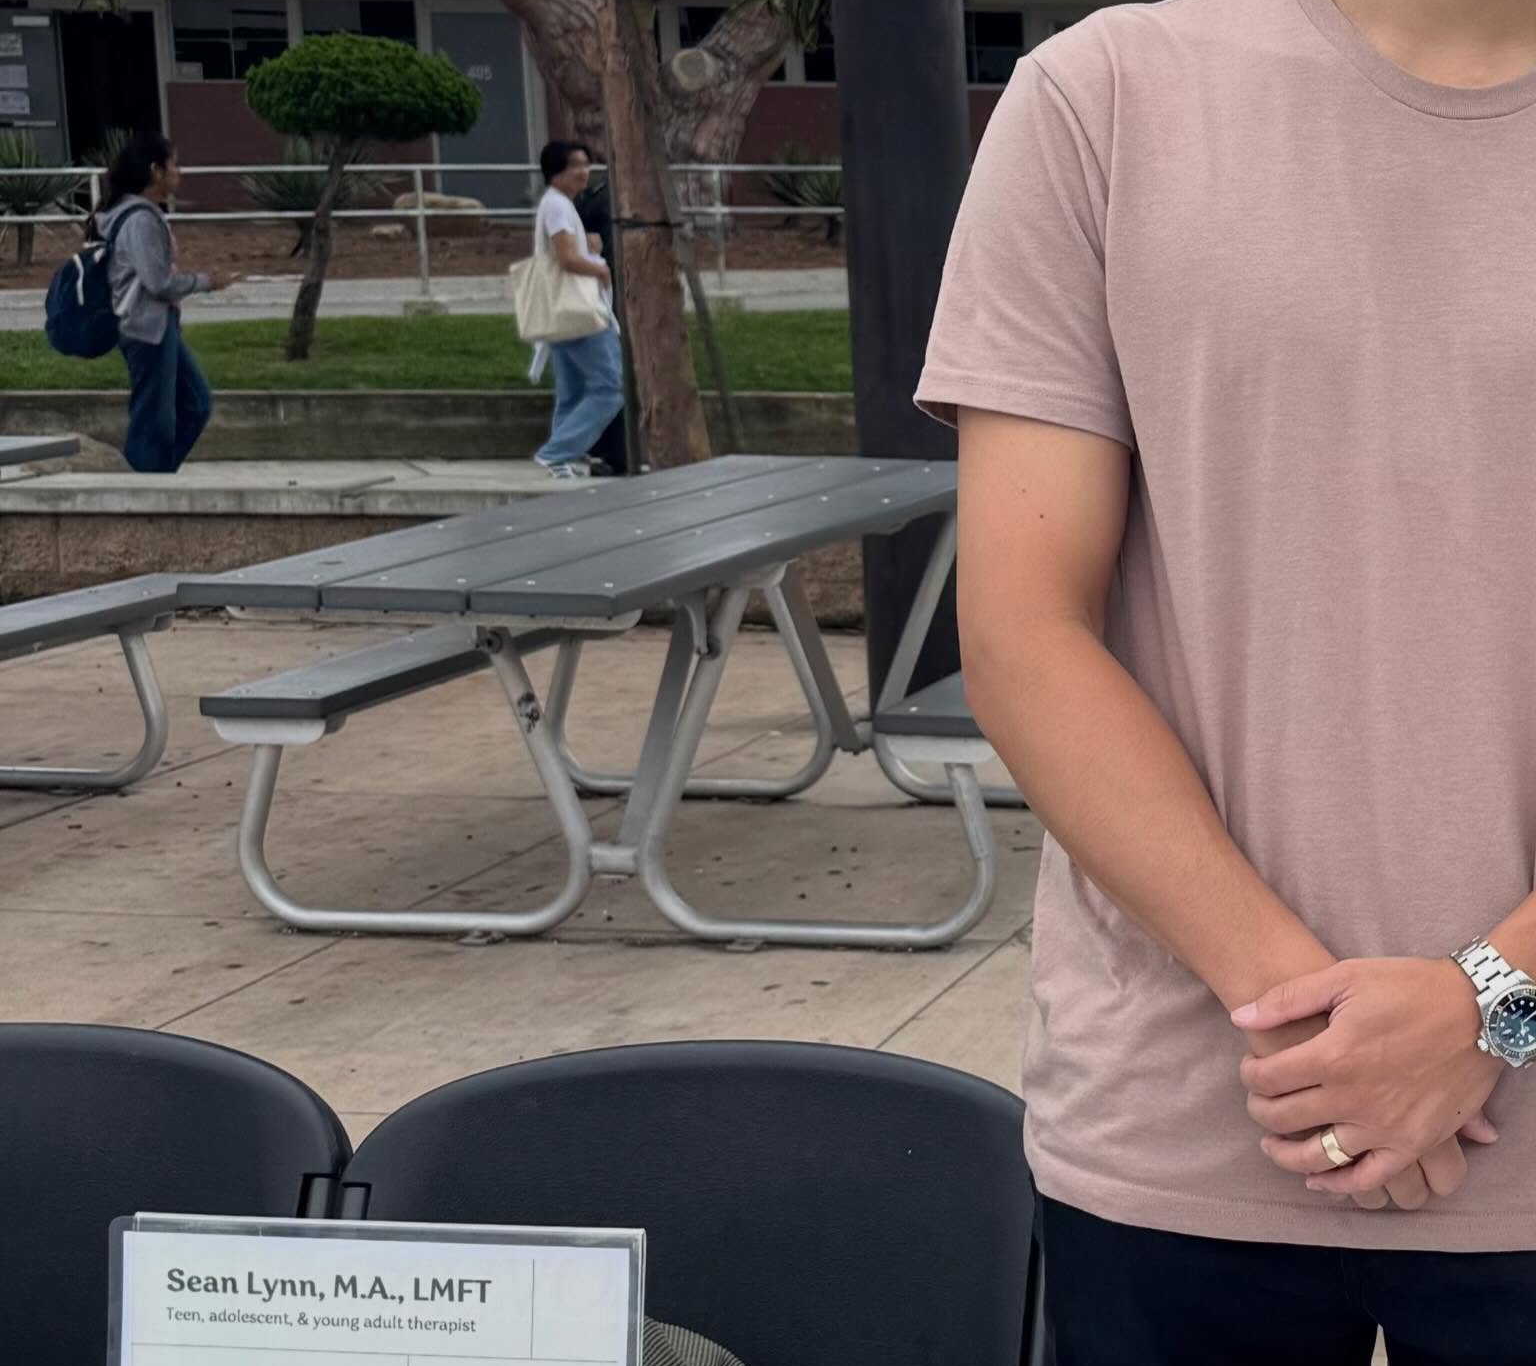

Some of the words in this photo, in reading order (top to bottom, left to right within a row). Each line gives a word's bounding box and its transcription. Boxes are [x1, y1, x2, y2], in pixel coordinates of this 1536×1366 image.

[167, 1268, 238, 1294] Sean
[247, 1271, 325, 1302] Lynn,
[333, 1276, 404, 1303] M.A.,
[413, 1278, 492, 1303] LMFT
[167, 1307, 204, 1324] Teen,
[209, 1309, 293, 1326] adolescent,
[313, 1314, 359, 1331] young
[363, 1315, 403, 1330] adult
[408, 1317, 476, 1334] therapist
